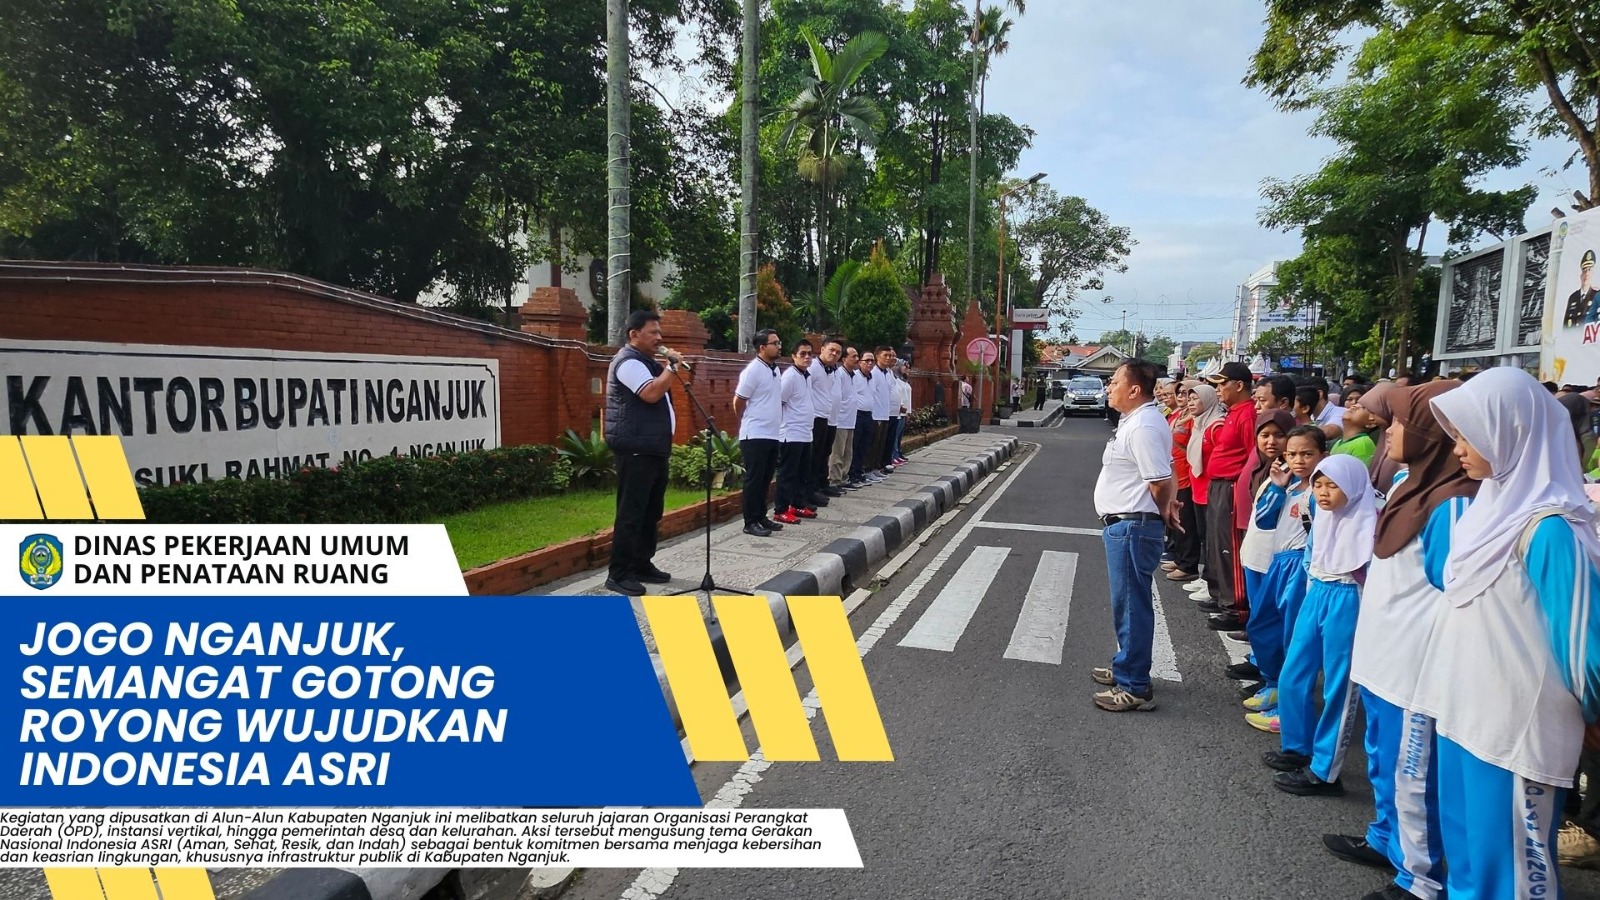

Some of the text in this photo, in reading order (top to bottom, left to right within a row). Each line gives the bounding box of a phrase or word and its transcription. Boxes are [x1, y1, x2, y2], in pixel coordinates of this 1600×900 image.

[6, 375, 488, 437] KANTOR BUPATI NGANJUK
[134, 462, 208, 488] SUKI
[225, 452, 330, 480] RAHMAT
